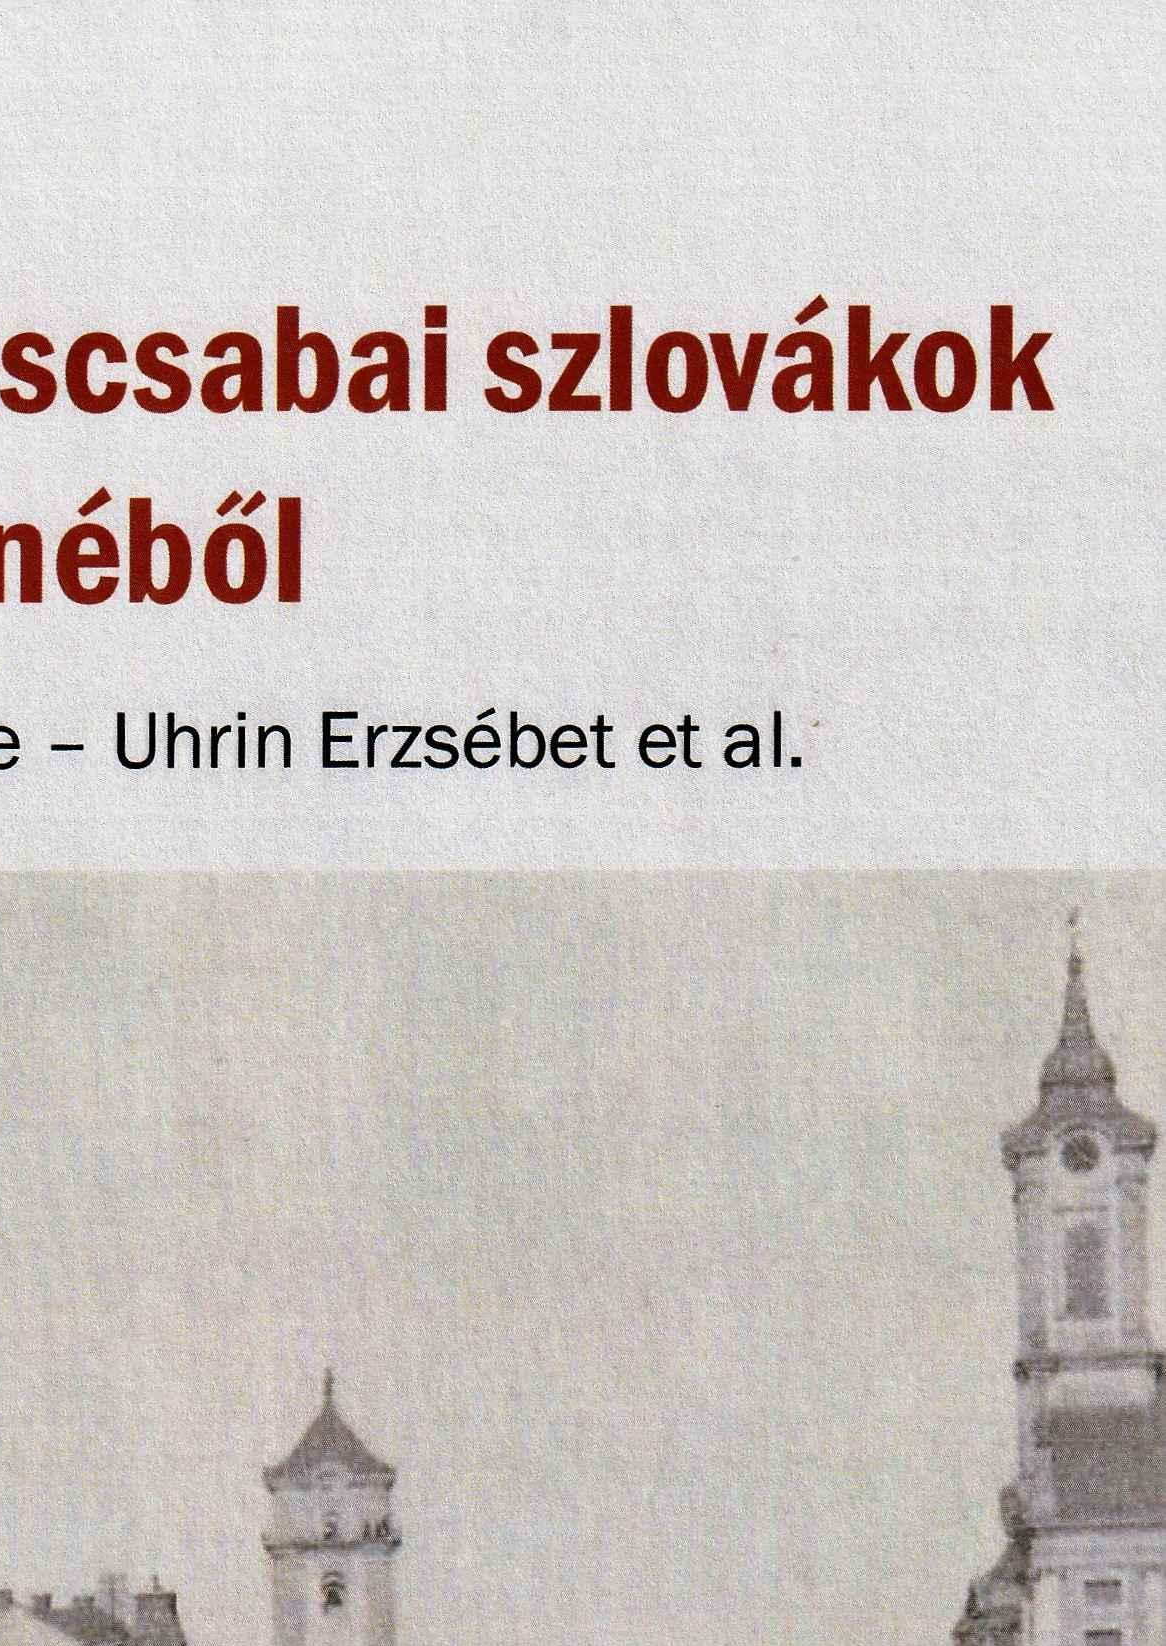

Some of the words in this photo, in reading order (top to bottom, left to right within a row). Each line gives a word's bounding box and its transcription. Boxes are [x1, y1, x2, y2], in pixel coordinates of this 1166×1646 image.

[484, 294, 1054, 413] szlovákok
[117, 712, 291, 769] Uhrin
[322, 707, 615, 769] Erzsébet
[638, 715, 702, 768] et
[724, 711, 802, 768] al.
